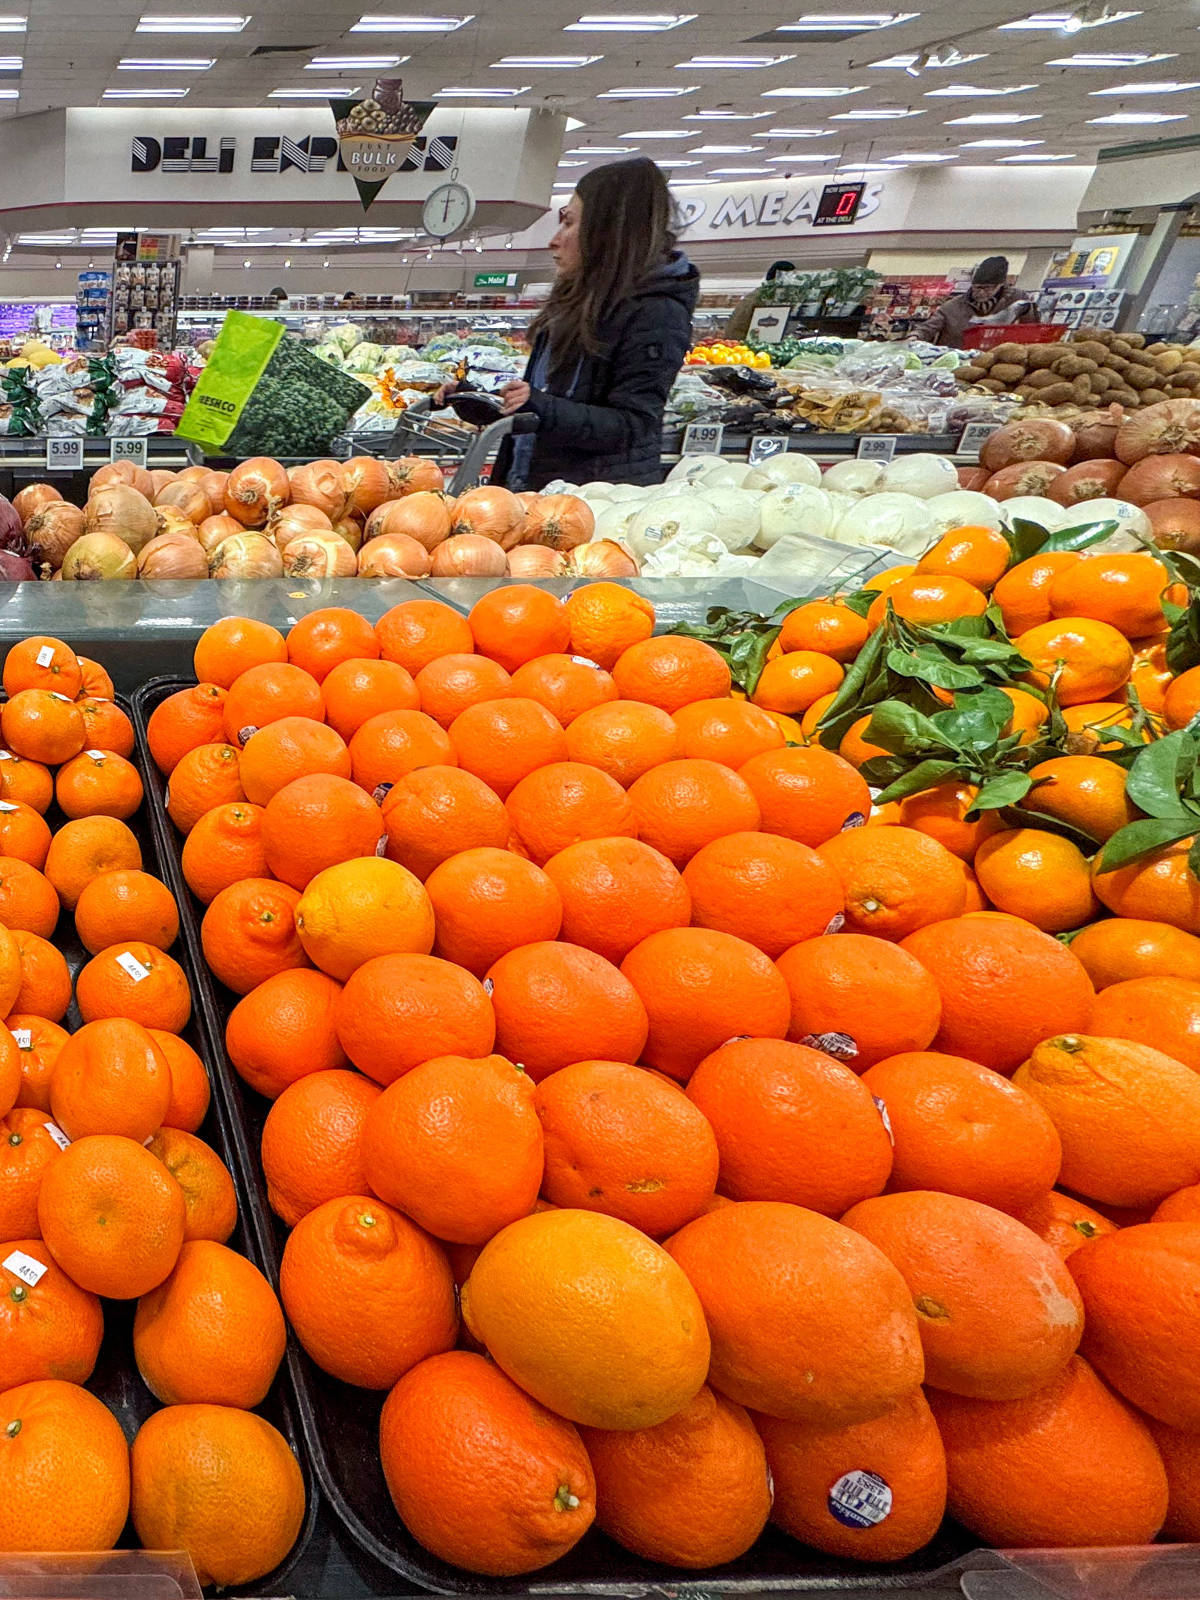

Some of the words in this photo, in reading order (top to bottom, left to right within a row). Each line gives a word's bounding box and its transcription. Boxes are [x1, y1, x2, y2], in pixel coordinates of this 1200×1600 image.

[132, 136, 236, 173] DELI
[251, 135, 458, 173] EXPSS
[351, 152, 396, 165] BULK
[709, 184, 884, 228] MEAS
[835, 192, 857, 215] 0
[689, 428, 717, 440] 4.99
[51, 442, 79, 455] 5.99
[115, 442, 143, 454] 5.99
[863, 441, 886, 452] 2.99
[17, 1036, 31, 1045] 450
[19, 1264, 38, 1282] 4450
[831, 1500, 872, 1527] Sunkist
